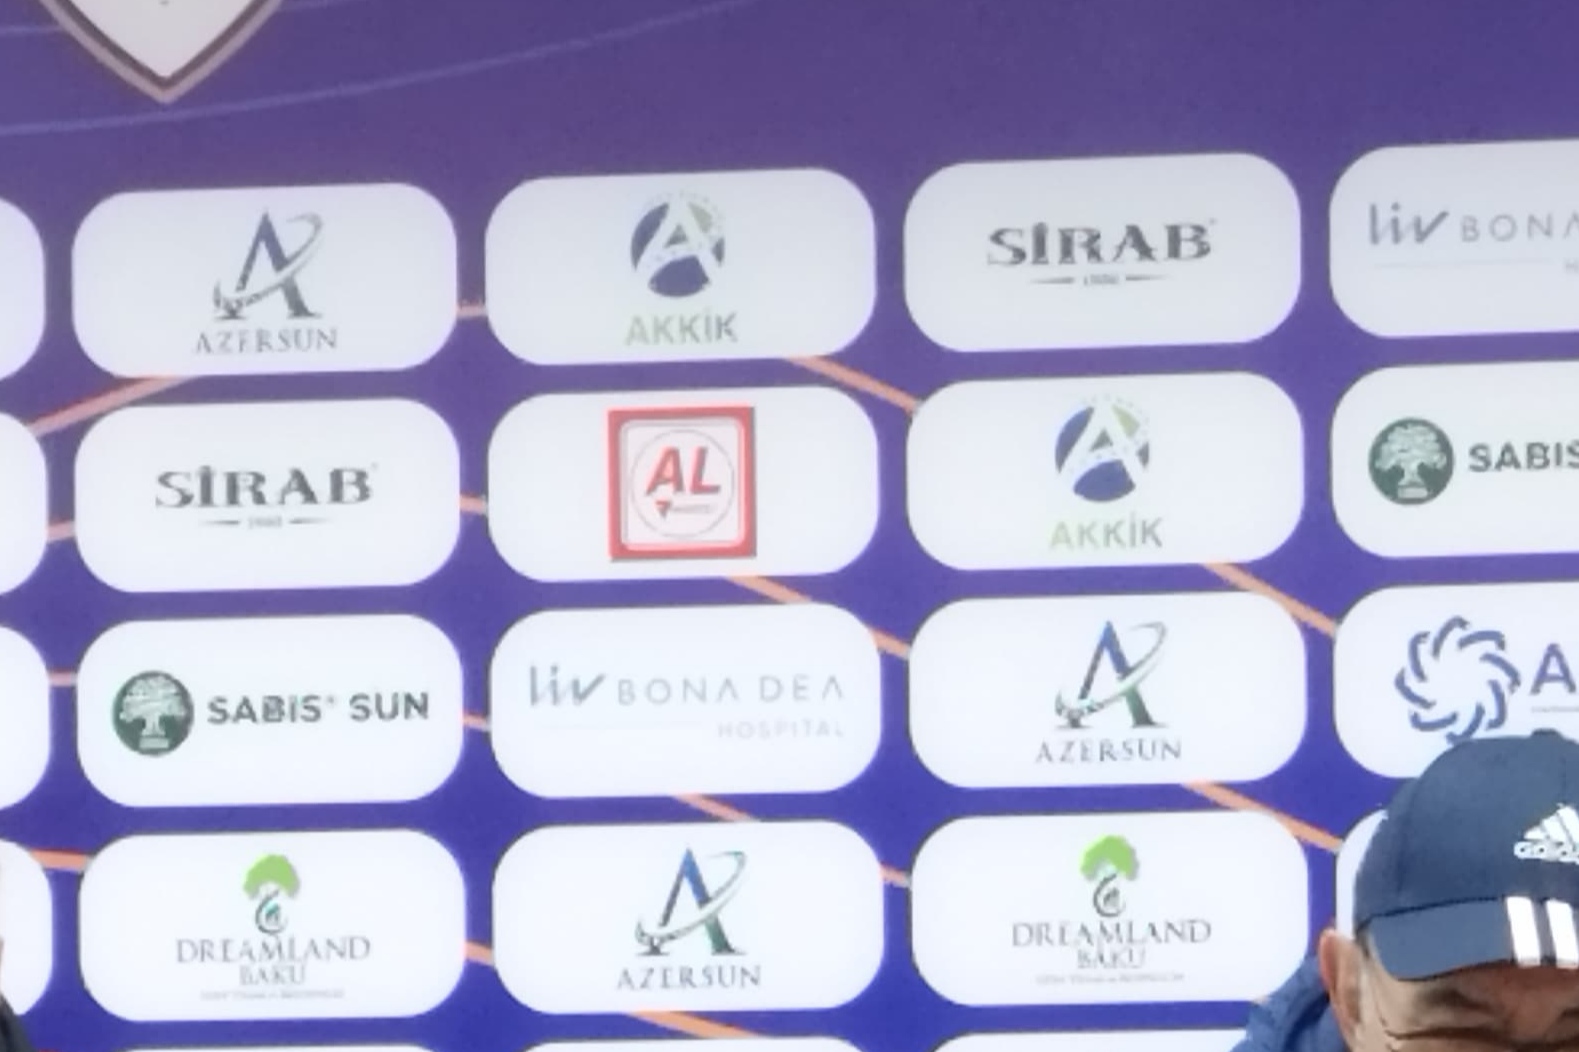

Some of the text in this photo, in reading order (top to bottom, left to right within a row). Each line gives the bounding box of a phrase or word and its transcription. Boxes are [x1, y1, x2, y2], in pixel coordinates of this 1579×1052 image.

[196, 327, 337, 354] AZERSUN
[646, 446, 721, 496] AL
[618, 677, 739, 706] BONA
[759, 673, 844, 703] DEA
[349, 692, 428, 722] SUN
[718, 718, 846, 740] HOSPITAL
[1036, 738, 1181, 763] AZERSUN
[1013, 918, 1211, 946] DREAMLAND
[177, 934, 371, 964] DREAMLAND
[1077, 945, 1145, 969] BAKU
[240, 963, 306, 986] BAKU
[618, 965, 760, 990] AZERSUN
